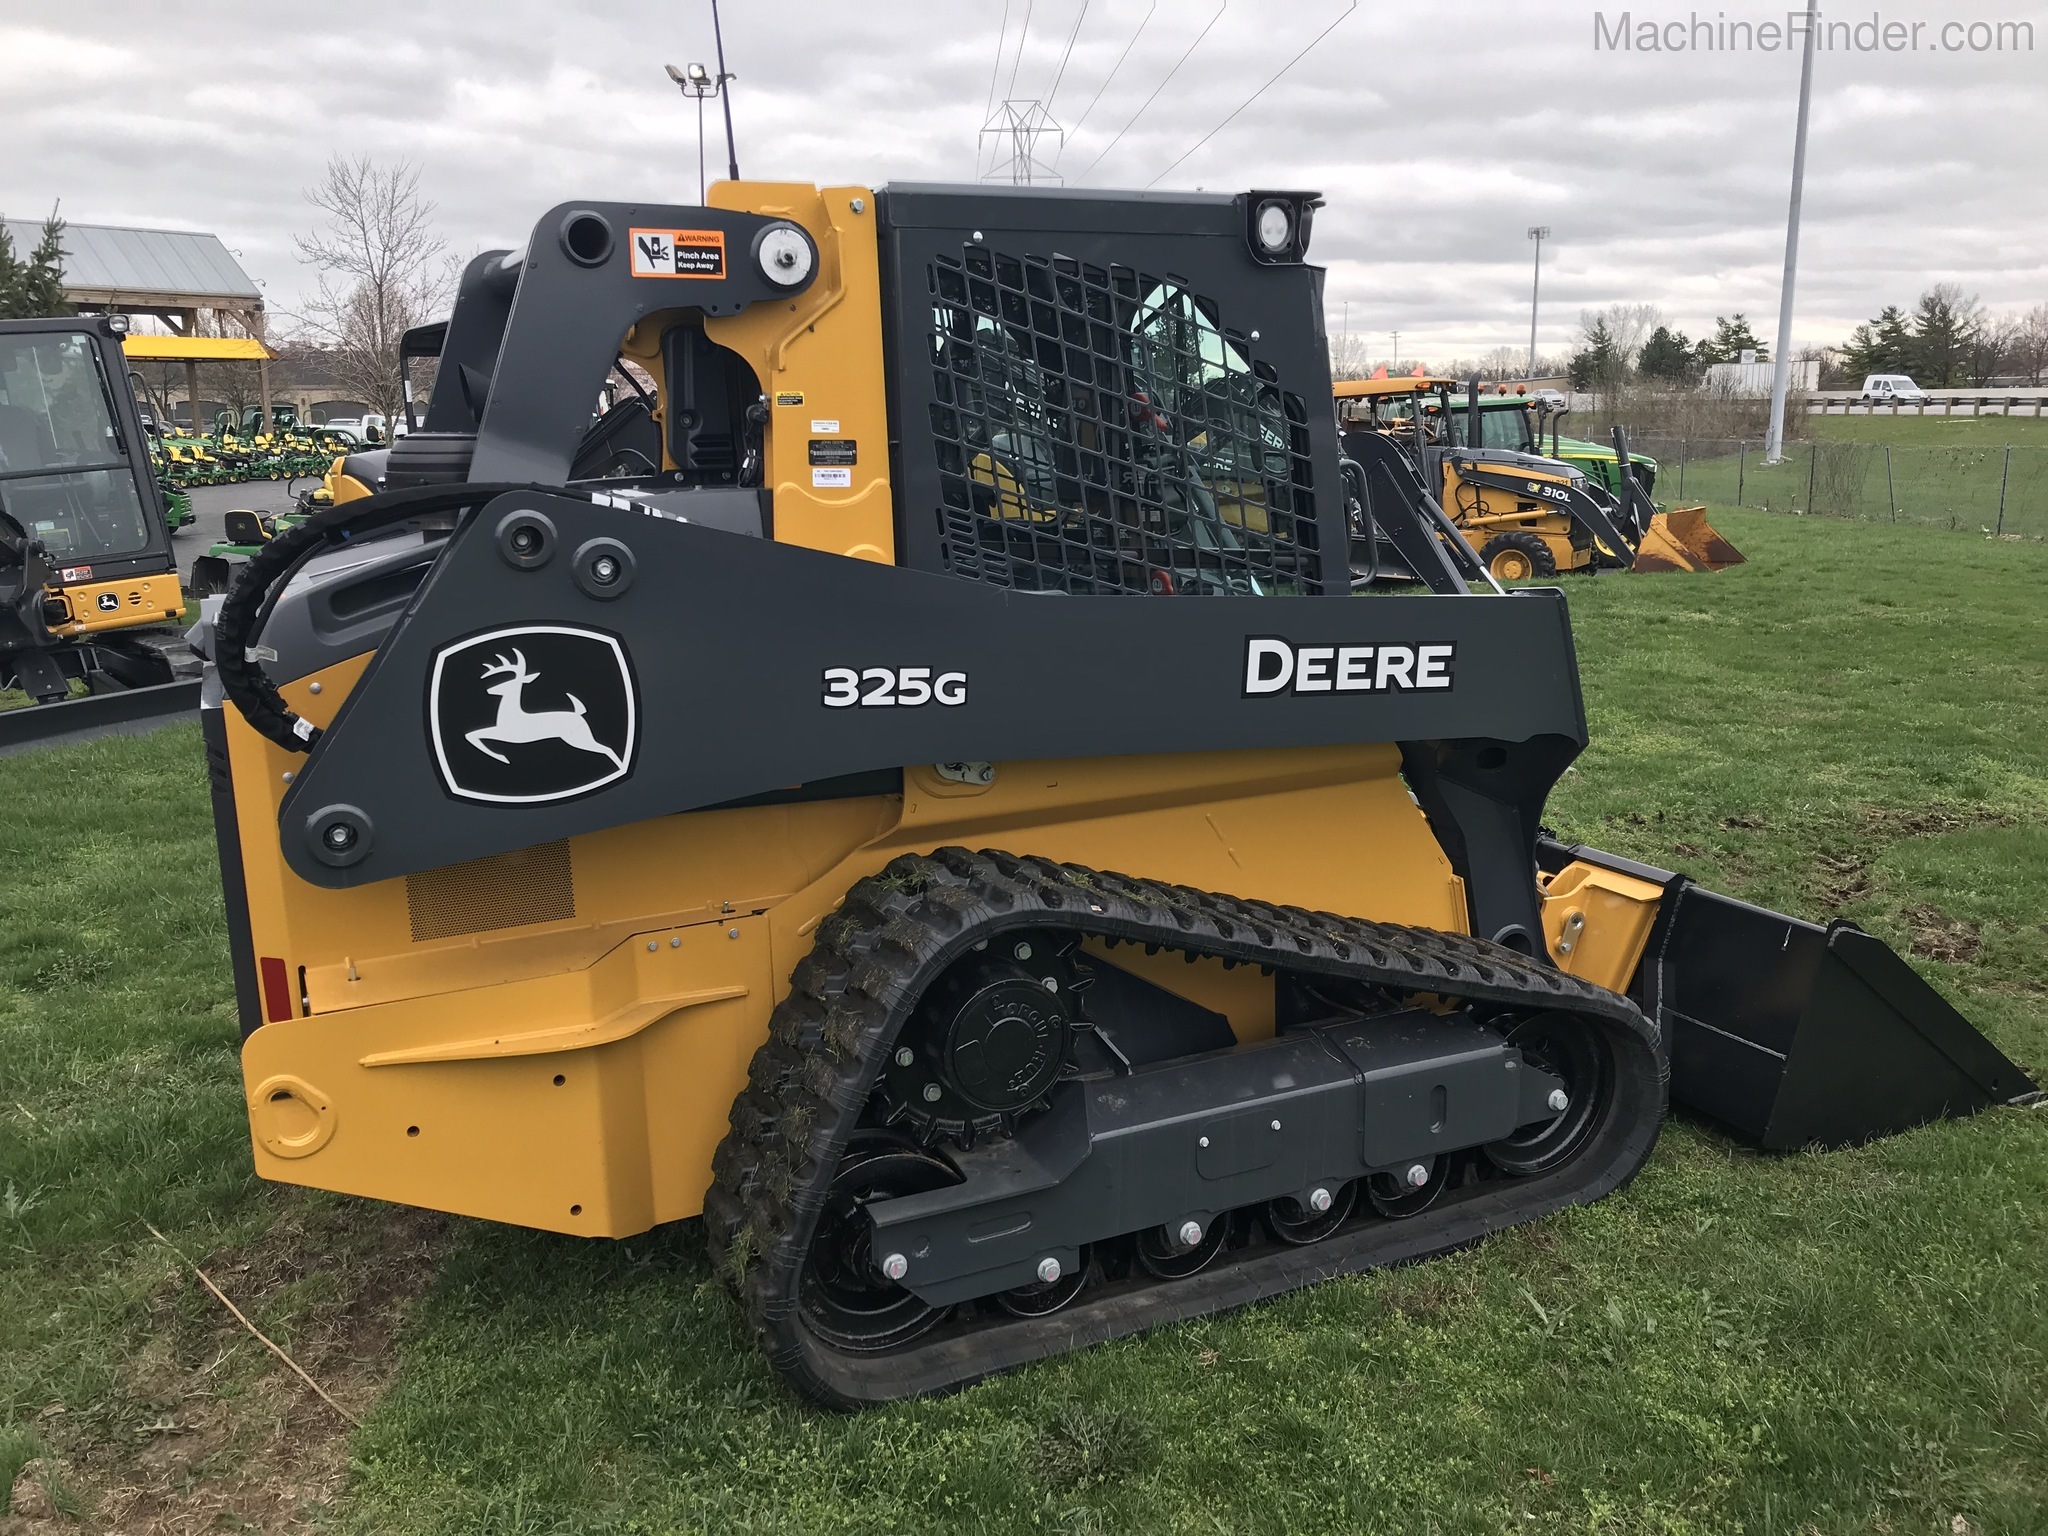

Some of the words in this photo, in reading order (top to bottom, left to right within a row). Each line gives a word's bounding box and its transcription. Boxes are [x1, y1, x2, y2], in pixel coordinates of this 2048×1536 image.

[684, 234, 719, 243] WARNING
[677, 251, 700, 260] Pinch
[701, 252, 719, 260] Area
[677, 261, 695, 270] Keep
[696, 262, 714, 270] Away
[1542, 486, 1571, 503] 310L
[1245, 638, 1454, 693] DEERE
[823, 667, 967, 707] 325G
